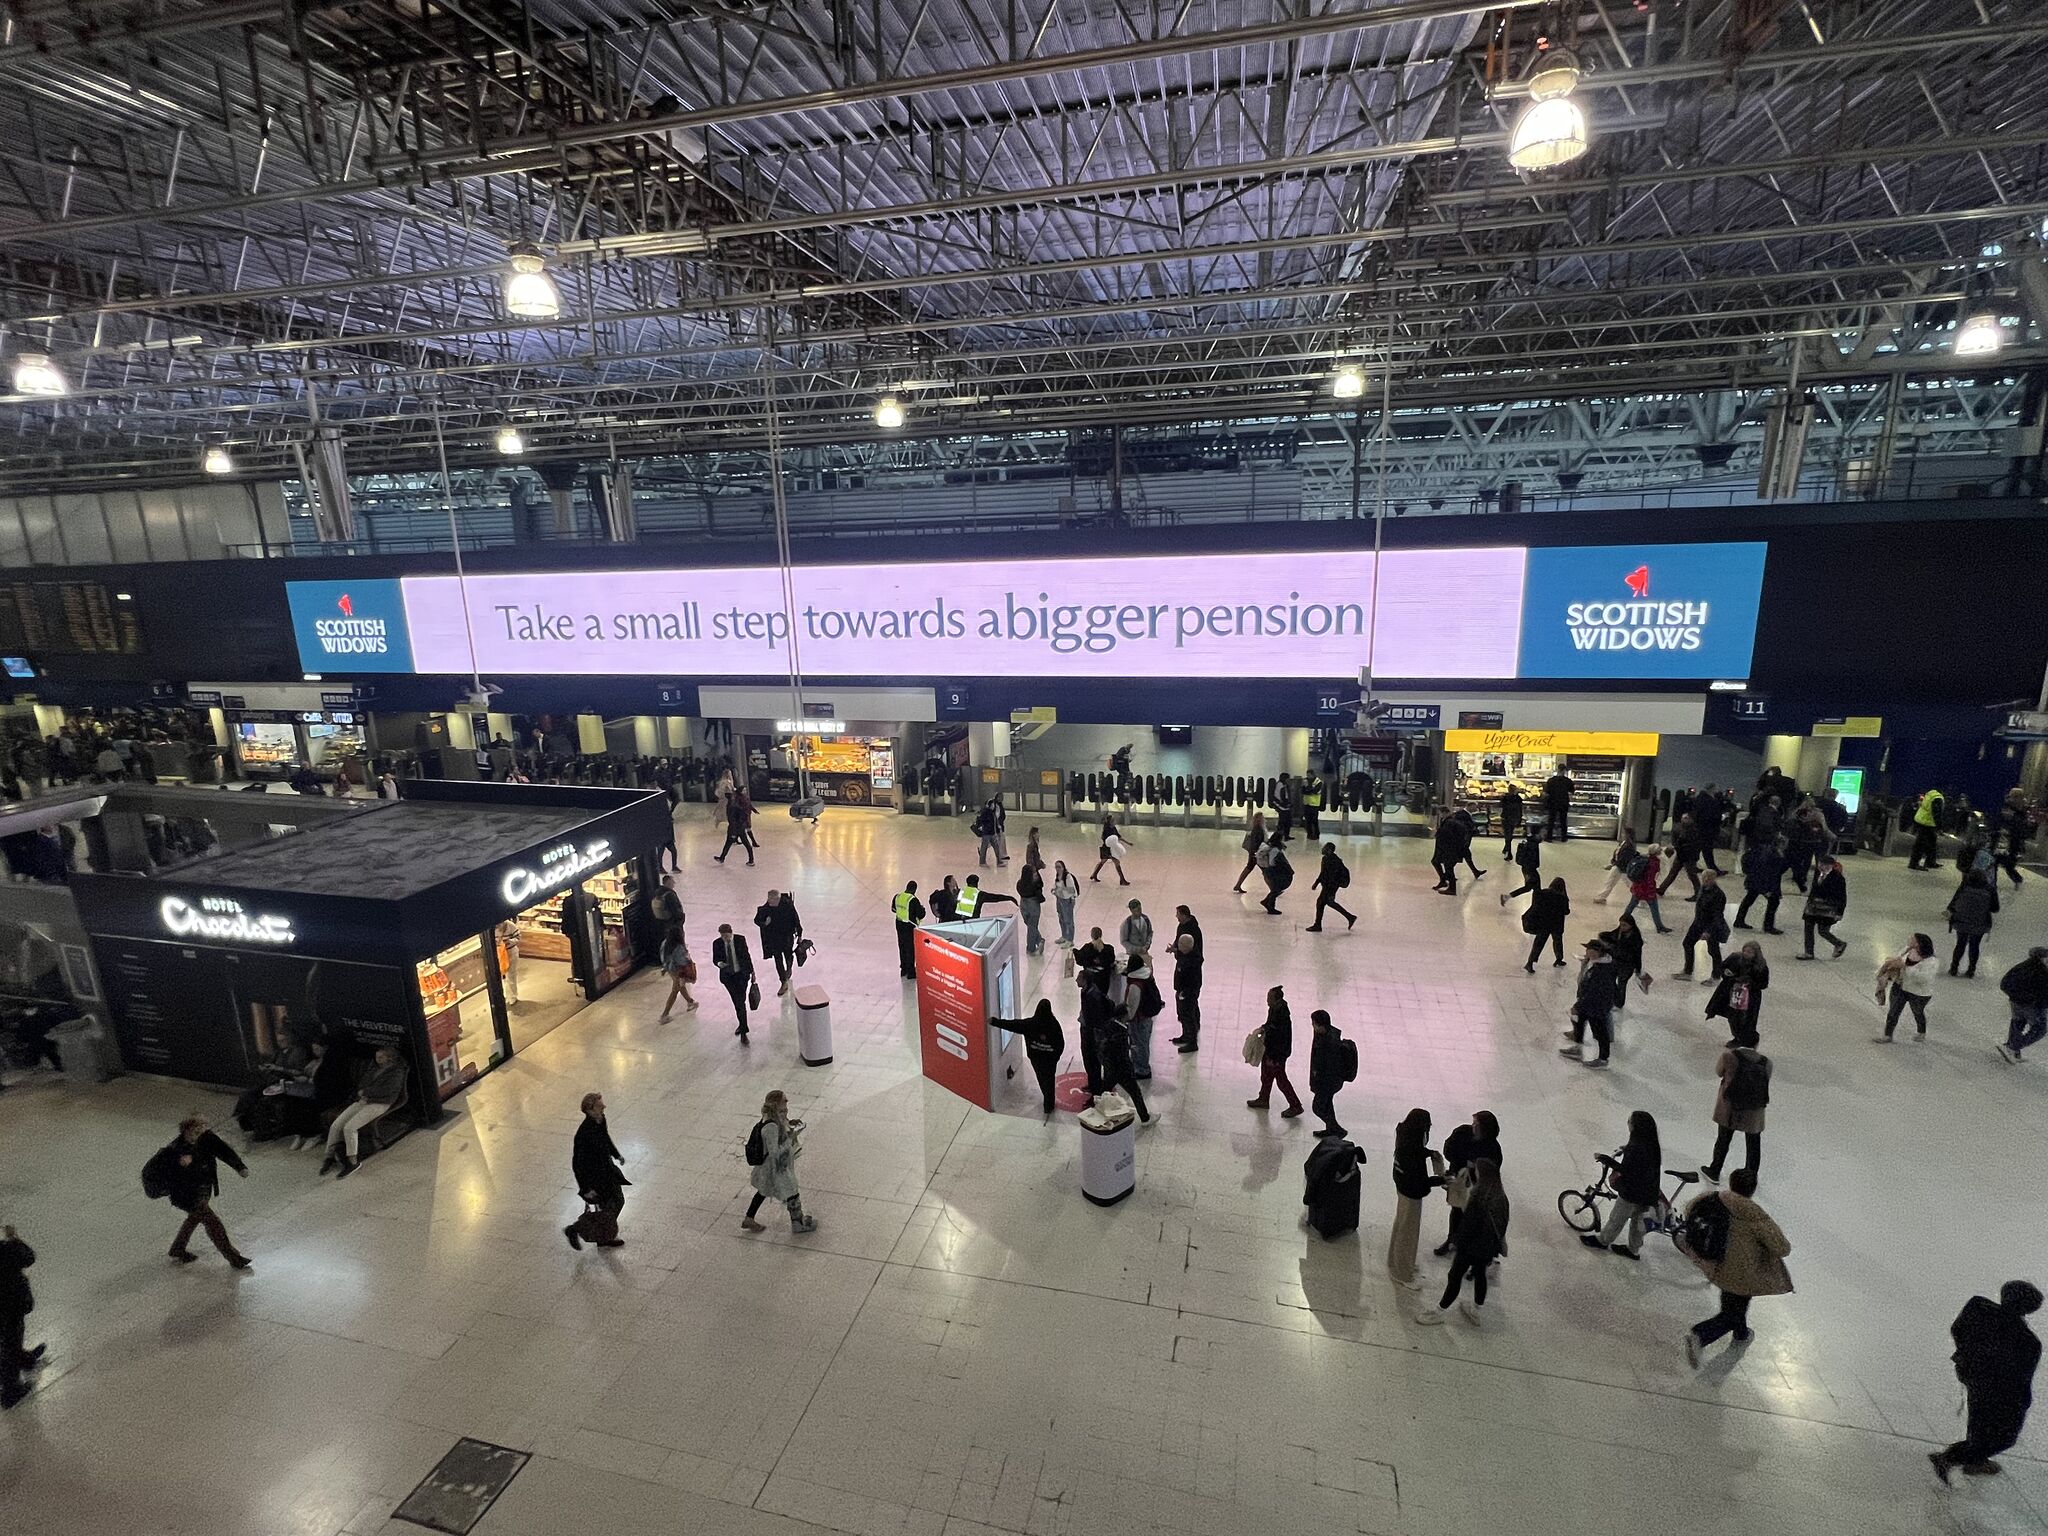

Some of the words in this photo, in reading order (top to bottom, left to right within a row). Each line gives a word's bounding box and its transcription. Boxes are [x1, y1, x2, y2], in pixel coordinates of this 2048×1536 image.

[495, 604, 575, 641] Take
[584, 613, 604, 641] a
[613, 601, 702, 641] small
[712, 604, 791, 650] step
[803, 597, 966, 639] towards
[977, 607, 1003, 639] a
[1005, 591, 1168, 654] bigger
[1175, 591, 1364, 648] pension
[1566, 602, 1708, 625] SCOTTISH
[315, 618, 386, 637] SCOTTISH
[320, 636, 388, 654] WIDOWS
[1570, 627, 1701, 650] WIDOWS
[662, 691, 671, 703] 8
[950, 693, 960, 706] 9
[1320, 696, 1338, 711] 10
[1745, 701, 1766, 715] 11
[1484, 732, 1524, 750] Upper
[1517, 732, 1557, 749] Crust
[542, 843, 577, 865] HOTEL
[202, 897, 244, 913] HOTEL
